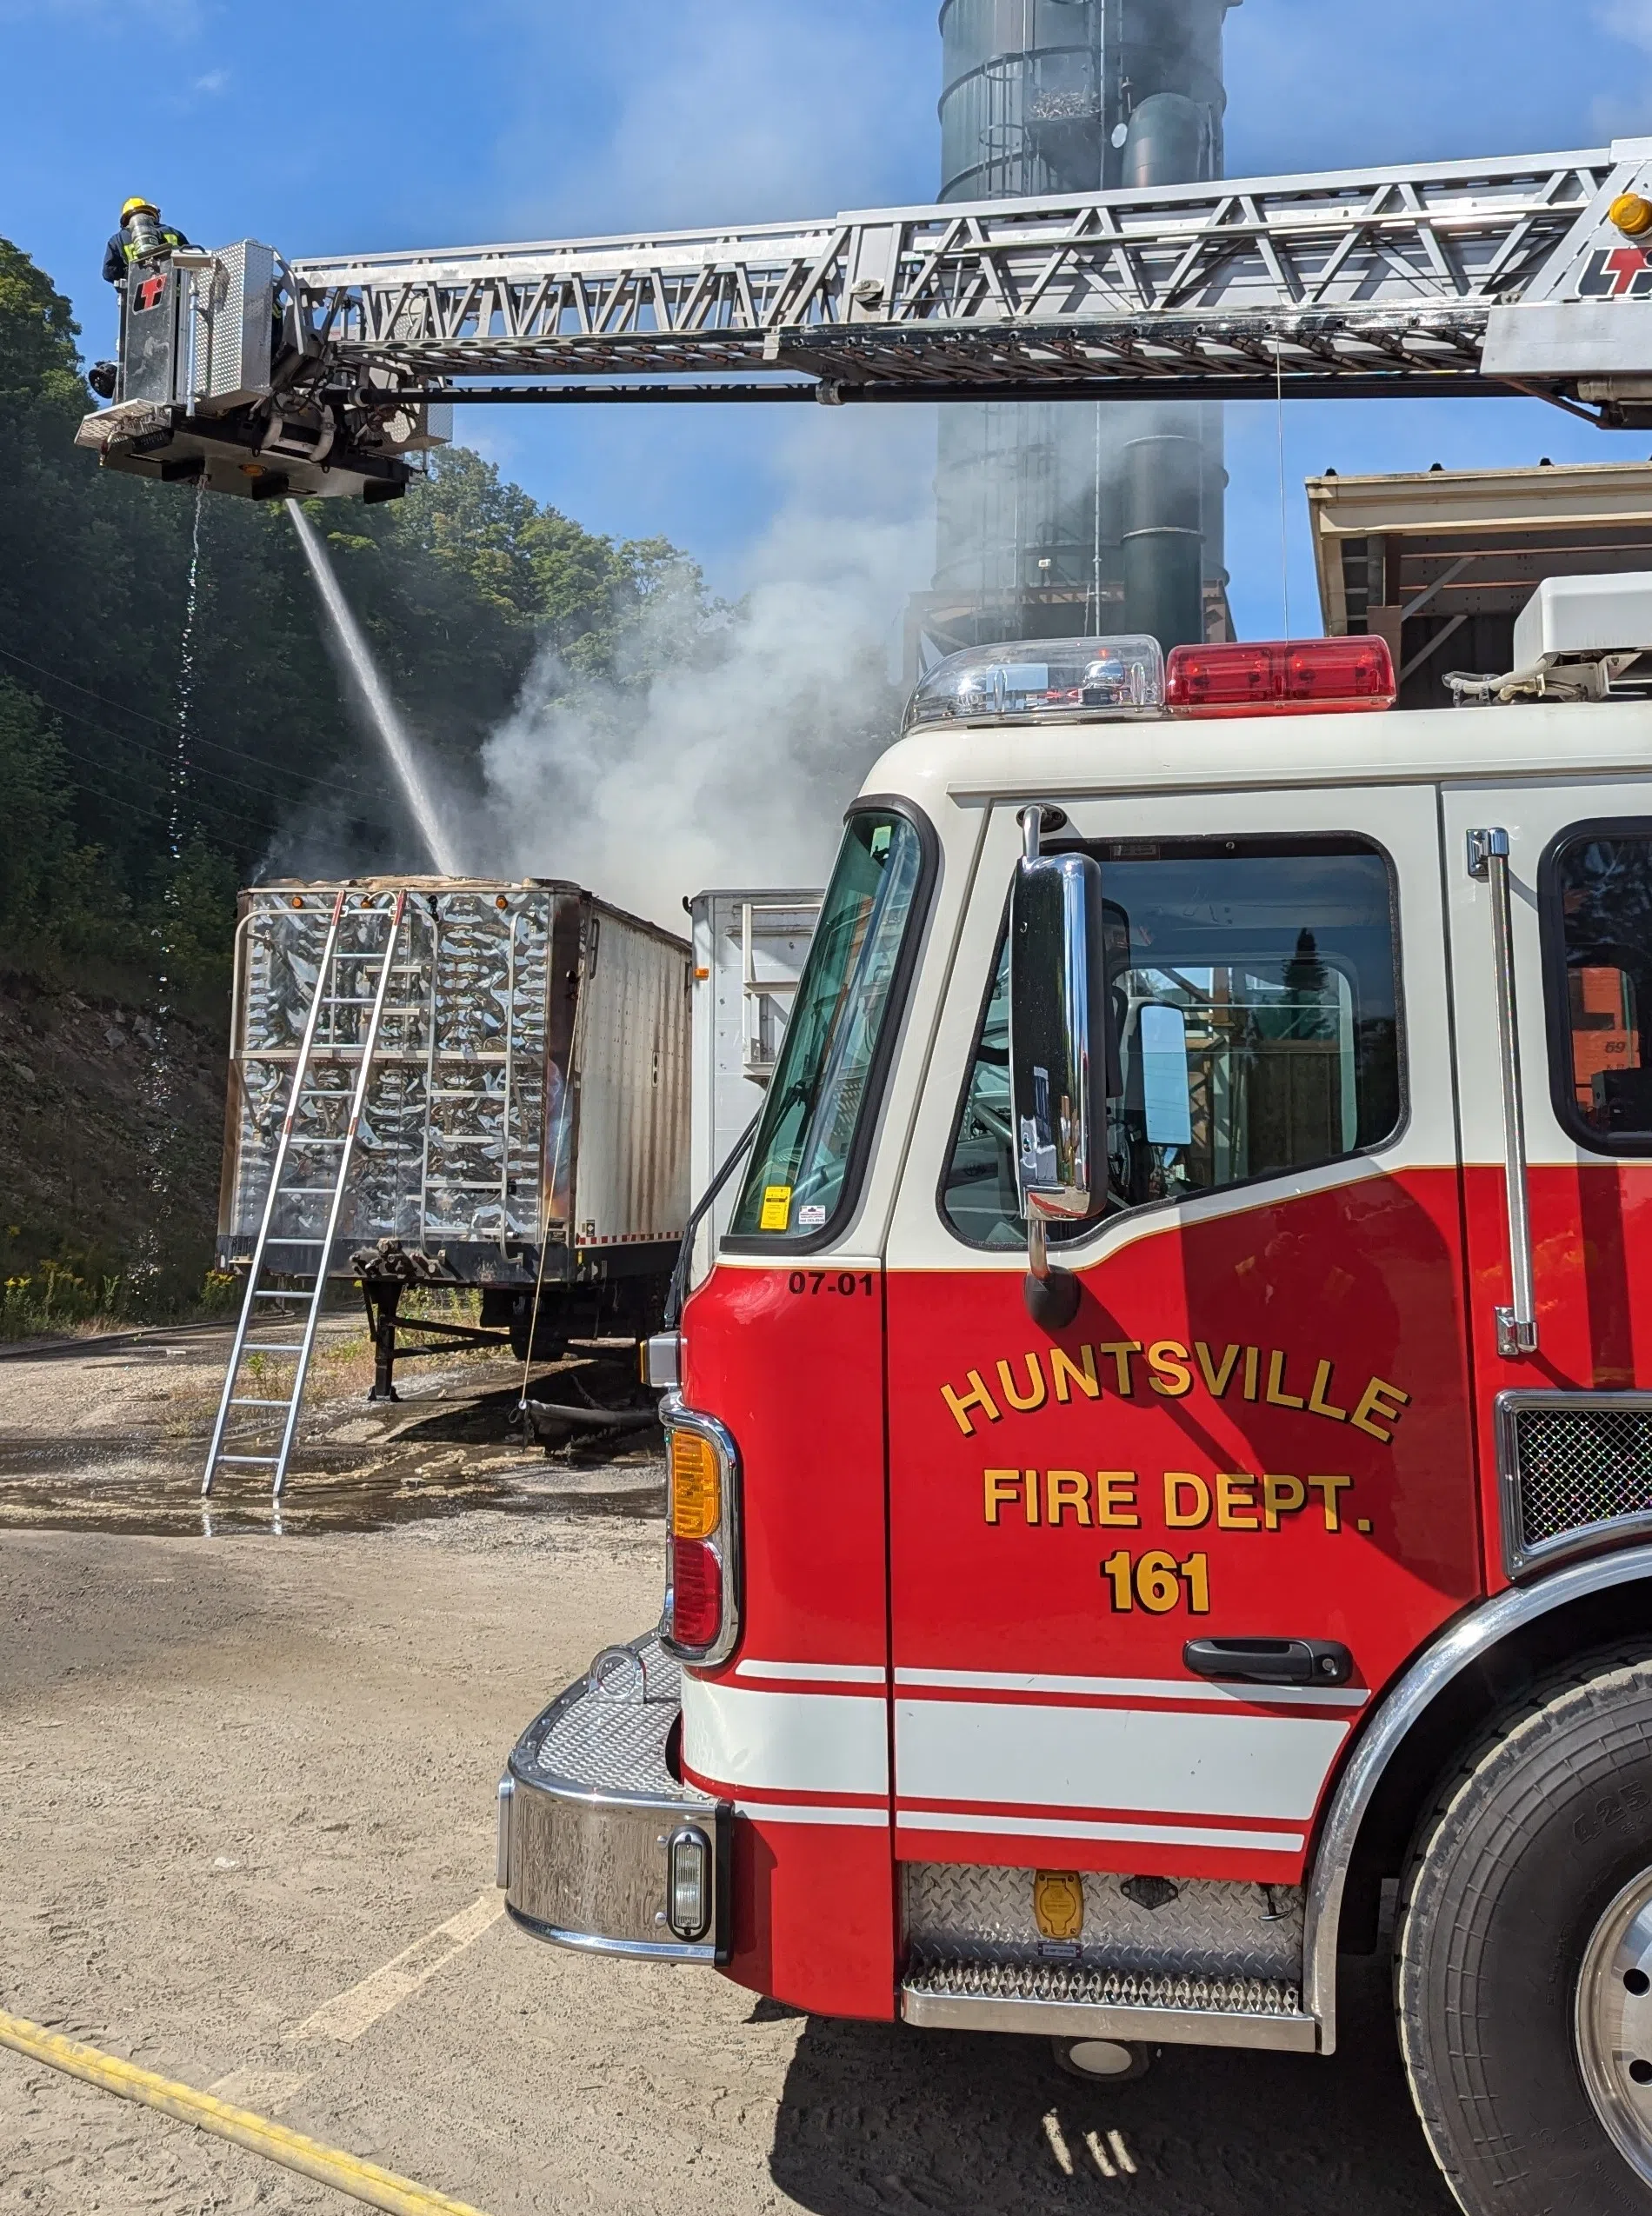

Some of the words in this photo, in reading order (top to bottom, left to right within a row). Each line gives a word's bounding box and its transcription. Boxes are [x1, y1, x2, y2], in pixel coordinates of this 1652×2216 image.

[789, 1271, 873, 1296] 07-01
[940, 1340, 1412, 1444] HUNTSVILLE
[983, 1468, 1142, 1528] FIRE
[1162, 1472, 1373, 1534] DEPT.
[1101, 1550, 1211, 1614] 161
